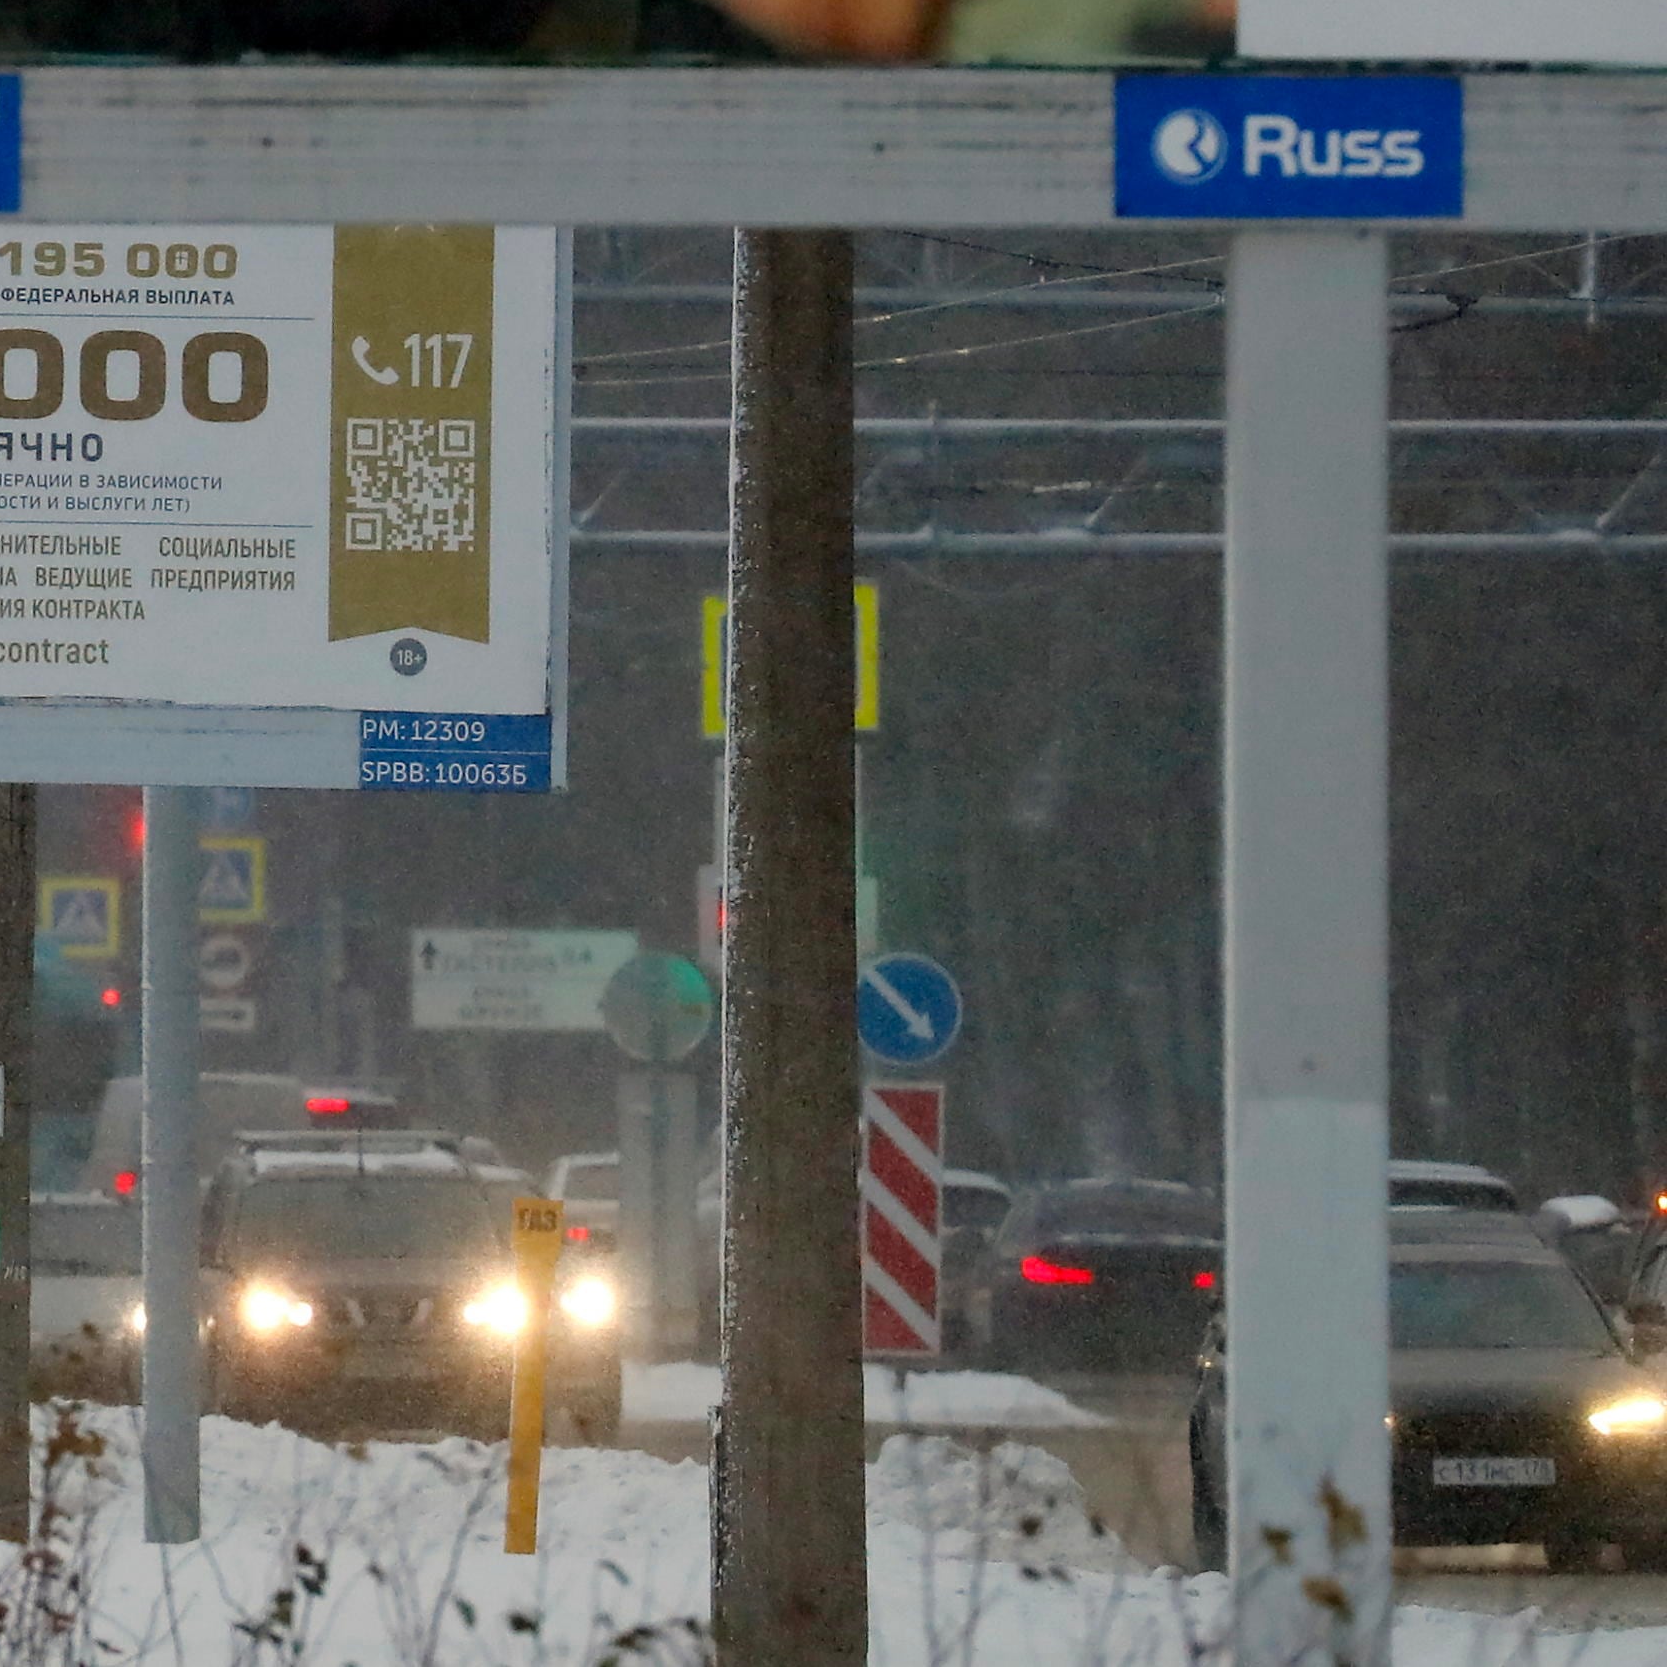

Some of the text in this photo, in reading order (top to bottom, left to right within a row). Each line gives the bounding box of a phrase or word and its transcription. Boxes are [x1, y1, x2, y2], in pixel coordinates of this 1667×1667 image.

[1243, 113, 1425, 178] Russ
[126, 243, 238, 280] 000
[1, 287, 140, 305] ФЕДЕРАЛЬНАЯ
[145, 288, 235, 306] ВЫПЛАТА
[404, 332, 473, 390] 117
[80, 475, 90, 488] В
[96, 475, 223, 491] ЗАВИСИМОСТИ
[48, 496, 59, 510] И
[66, 496, 146, 512] ВЫСЛУГИ
[151, 497, 191, 513] ЛЕТ)
[159, 536, 296, 561] СОЦИАЛЬНЫЕ
[35, 567, 132, 590] ВЕДУЩИЕ
[150, 568, 296, 593] ПРЕДПРИЯТИЯ
[31, 599, 145, 621] КОНТРАКТА
[397, 649, 424, 666] 18+
[411, 719, 487, 744] 12309
[518, 1209, 558, 1233] ГАЗ
